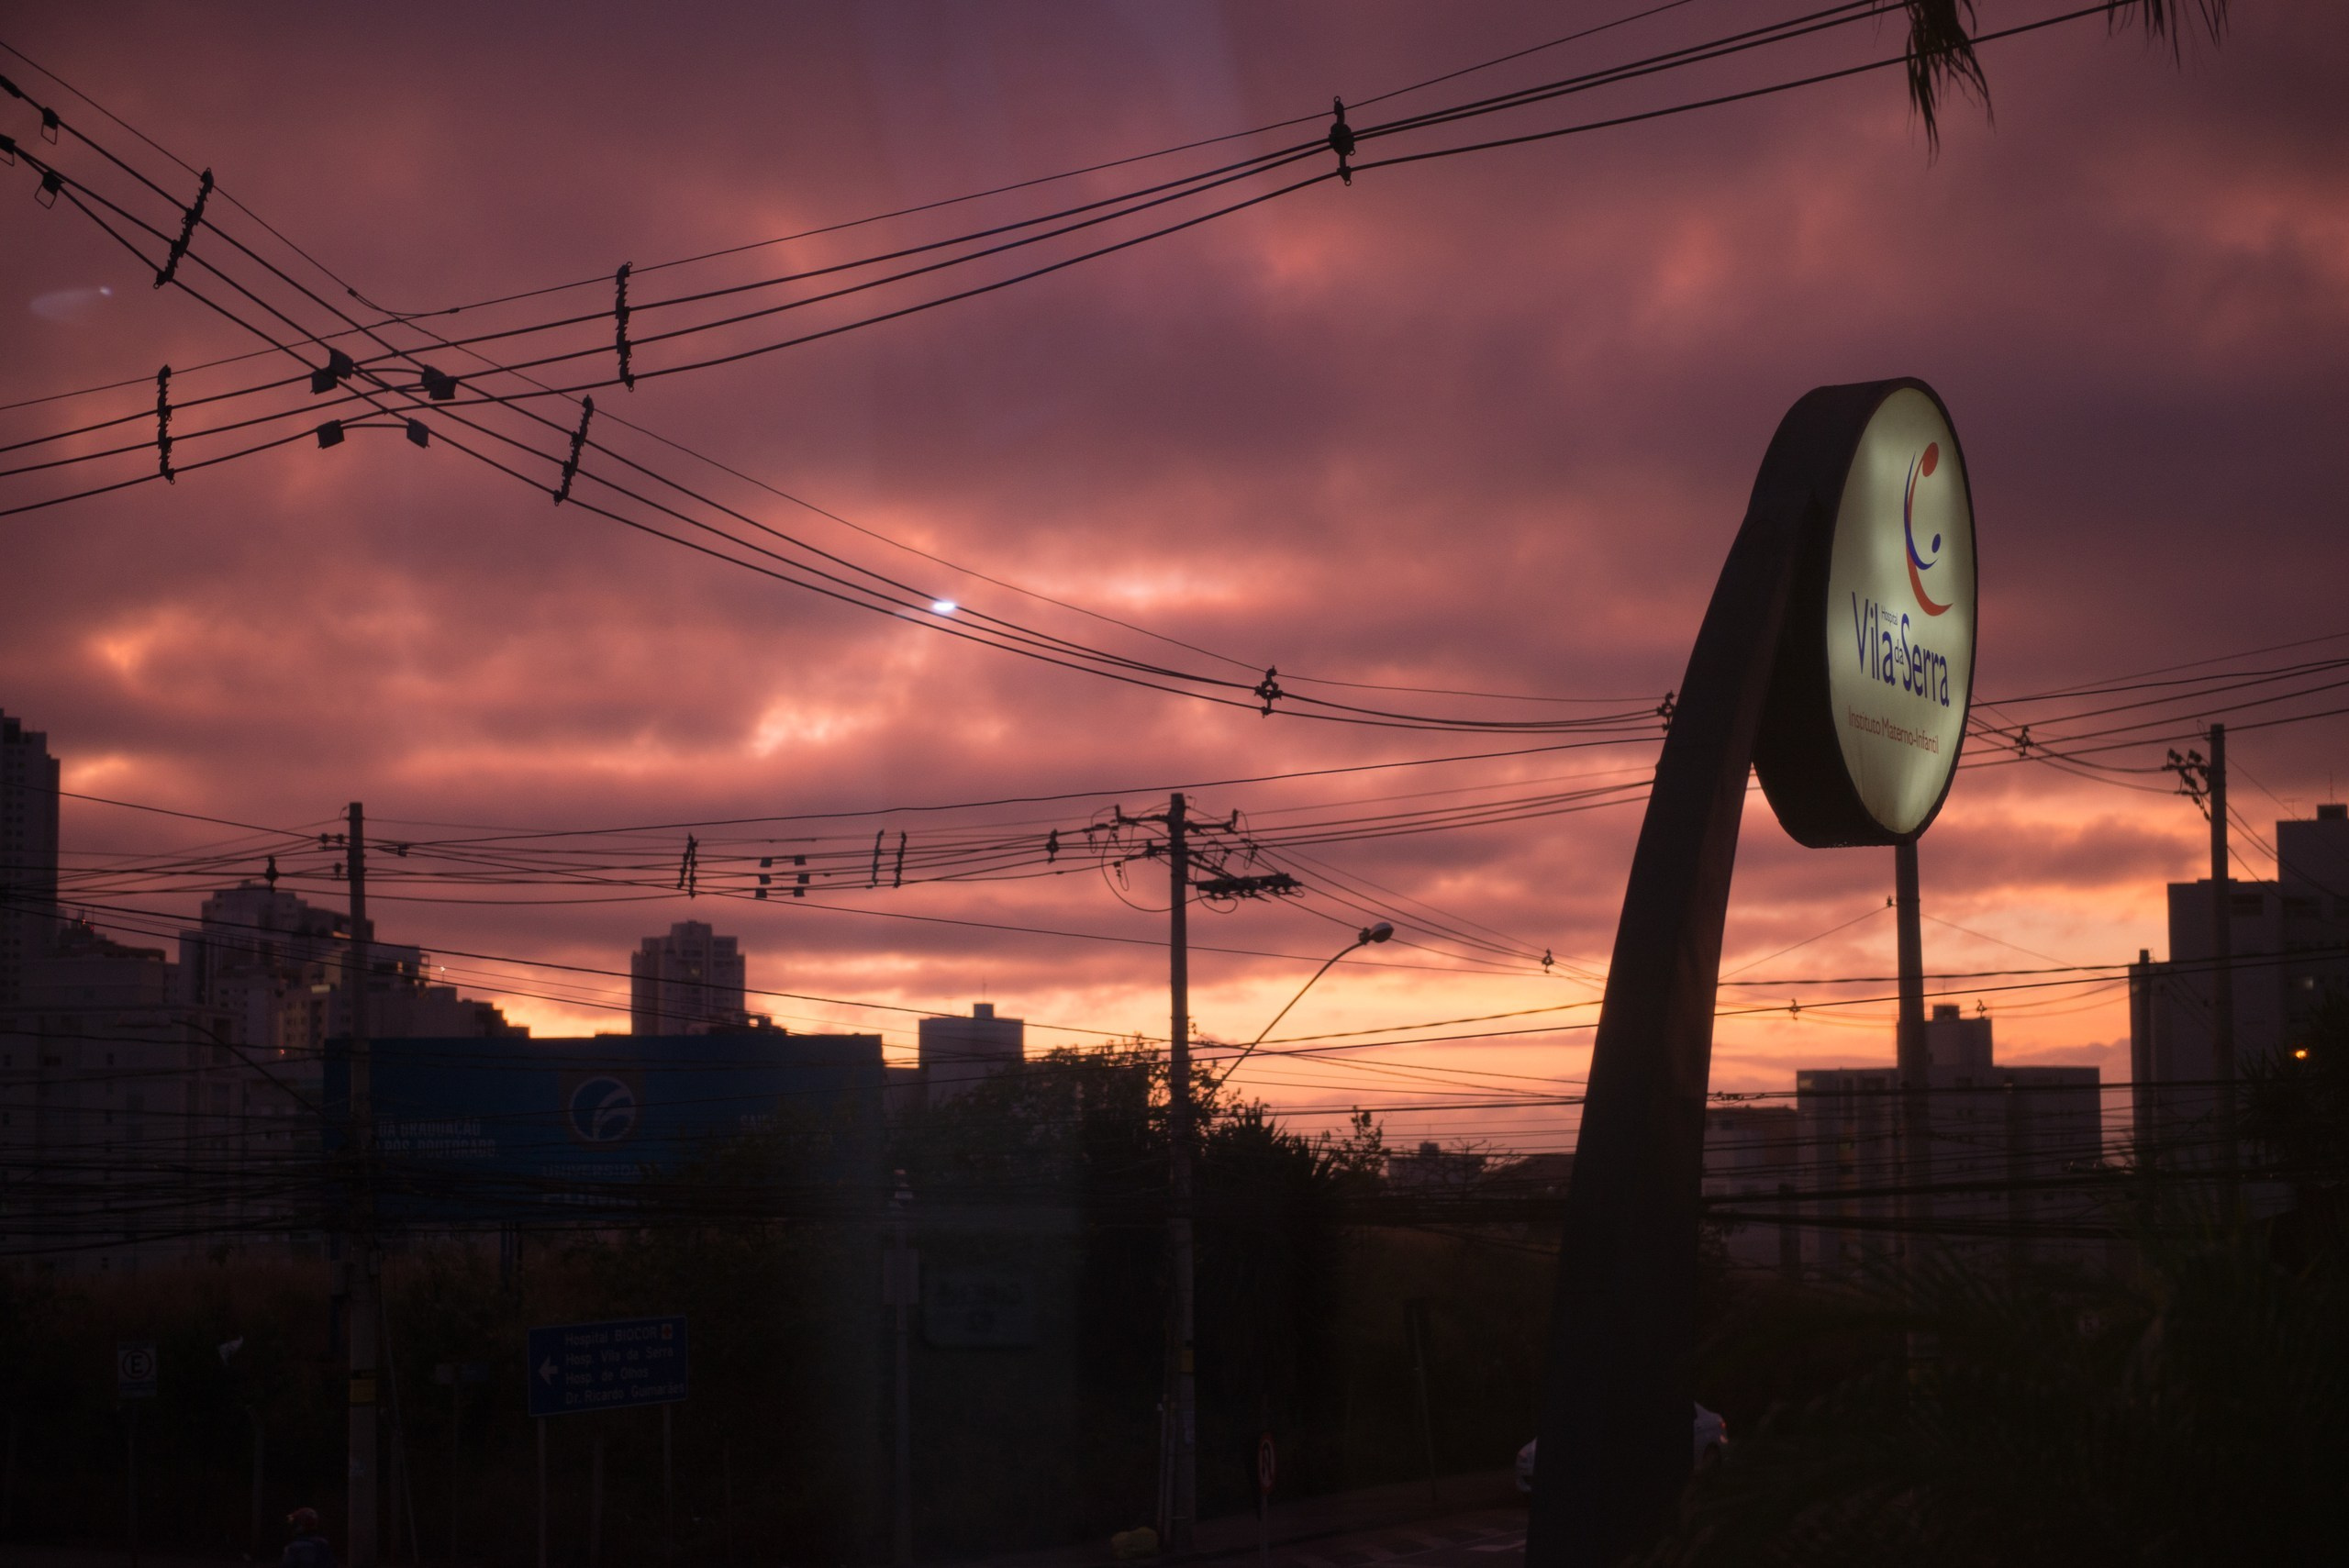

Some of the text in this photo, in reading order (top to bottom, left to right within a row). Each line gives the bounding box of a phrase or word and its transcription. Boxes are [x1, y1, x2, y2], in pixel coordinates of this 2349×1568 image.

[1881, 606, 1898, 626] Hospital
[1852, 592, 1950, 707] Vila da Serra
[1881, 717, 1940, 754] Materno-Infantil
[542, 1163, 662, 1177] UNIVERSIDA
[564, 1326, 658, 1348] Hospital BIOCOR
[130, 1355, 143, 1373] E
[565, 1345, 674, 1367] Hosp. Vila da Serra
[565, 1365, 650, 1386] Hosp. de Olhos
[565, 1382, 685, 1405] Dr. Ricardo Guimarães
